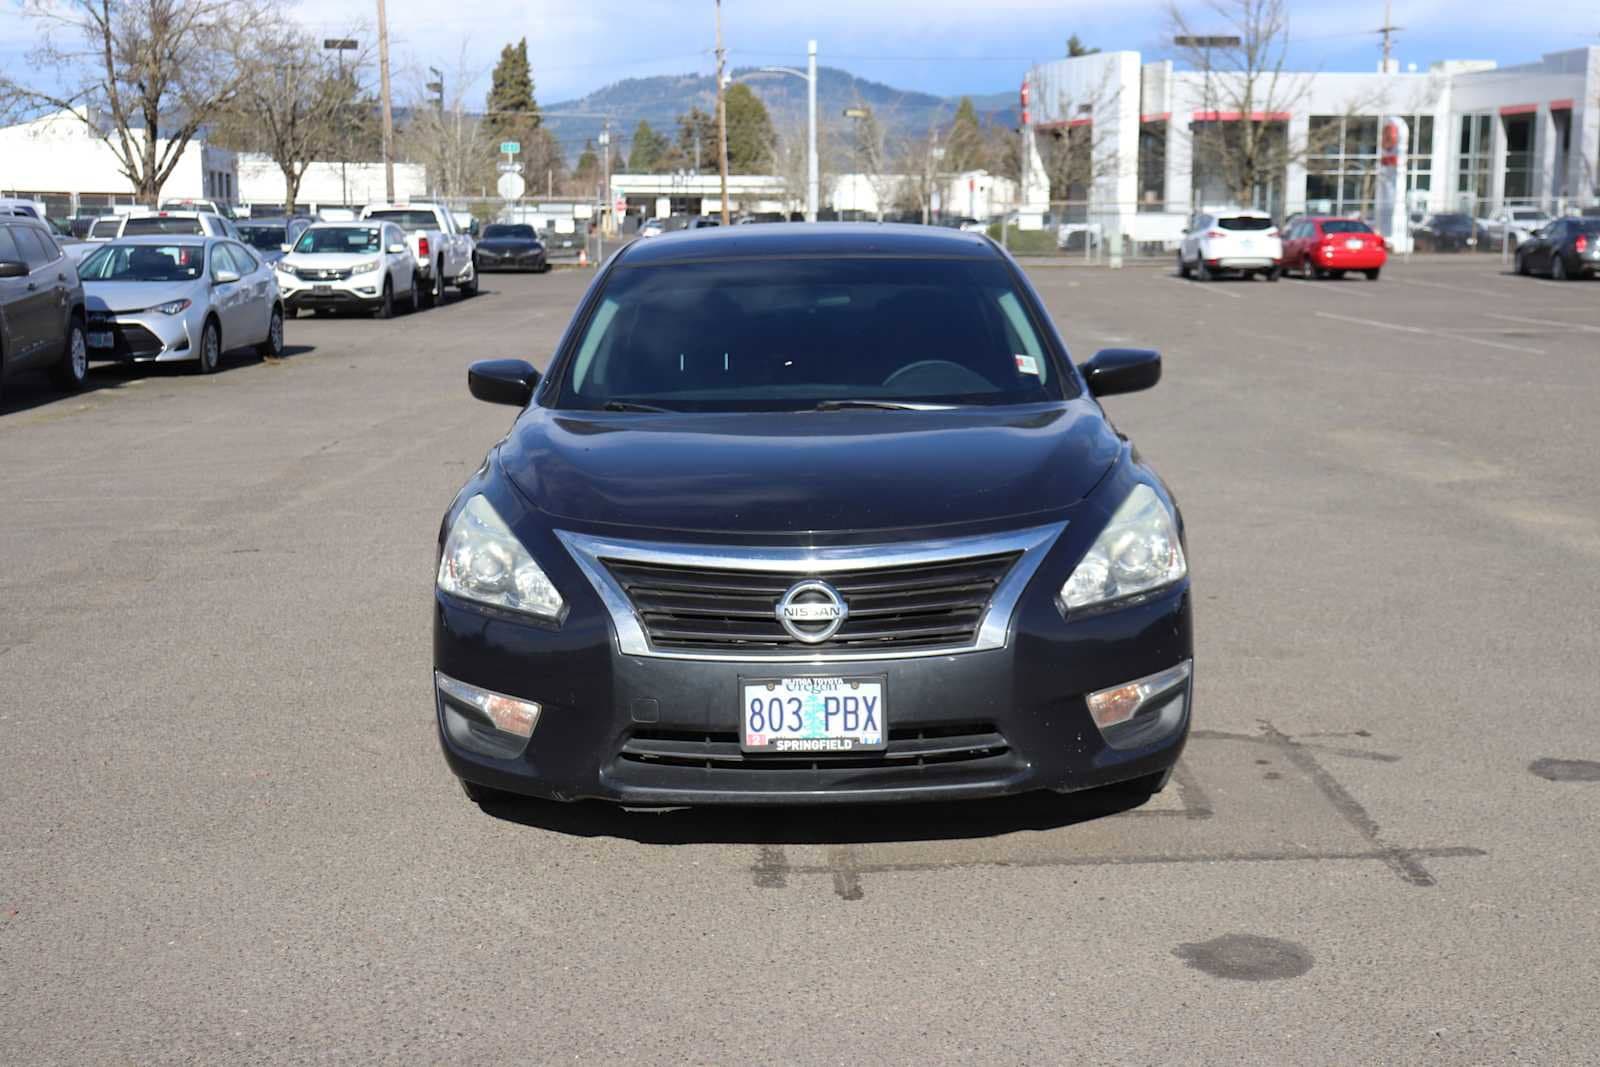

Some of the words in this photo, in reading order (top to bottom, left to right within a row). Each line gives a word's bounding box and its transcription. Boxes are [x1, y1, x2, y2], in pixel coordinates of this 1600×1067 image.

[784, 607, 841, 617] NISAN
[749, 697, 804, 732] 803
[825, 696, 878, 731] PBX
[776, 739, 852, 750] SPRINGFIELD
